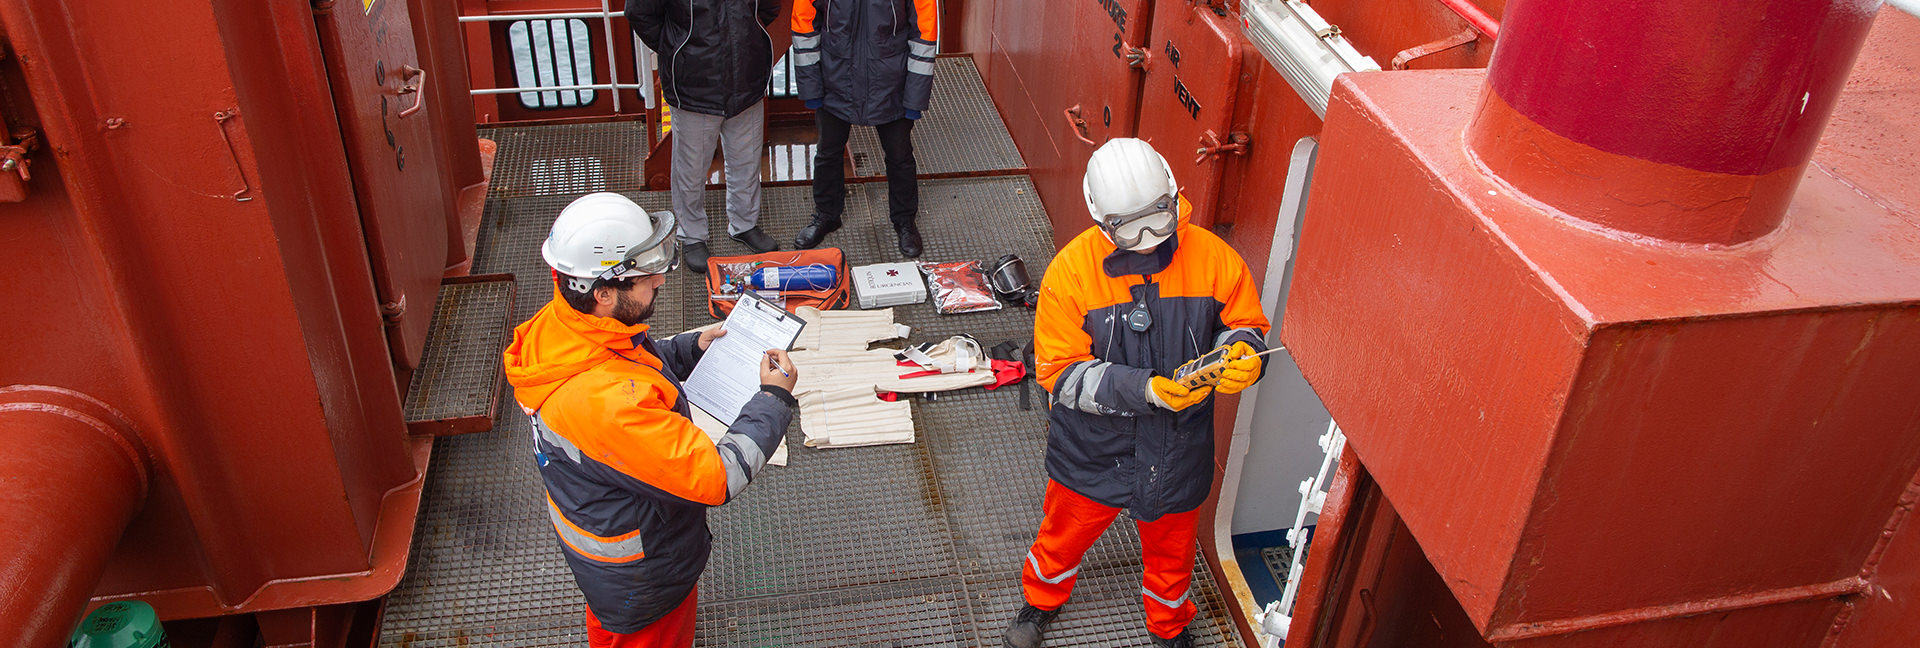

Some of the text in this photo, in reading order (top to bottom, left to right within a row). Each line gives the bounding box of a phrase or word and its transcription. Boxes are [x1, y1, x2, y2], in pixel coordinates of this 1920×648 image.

[1098, 0, 1127, 33] ORE
[1112, 33, 1122, 59] 2
[1165, 40, 1180, 69] AIR
[1174, 74, 1201, 120] VENT
